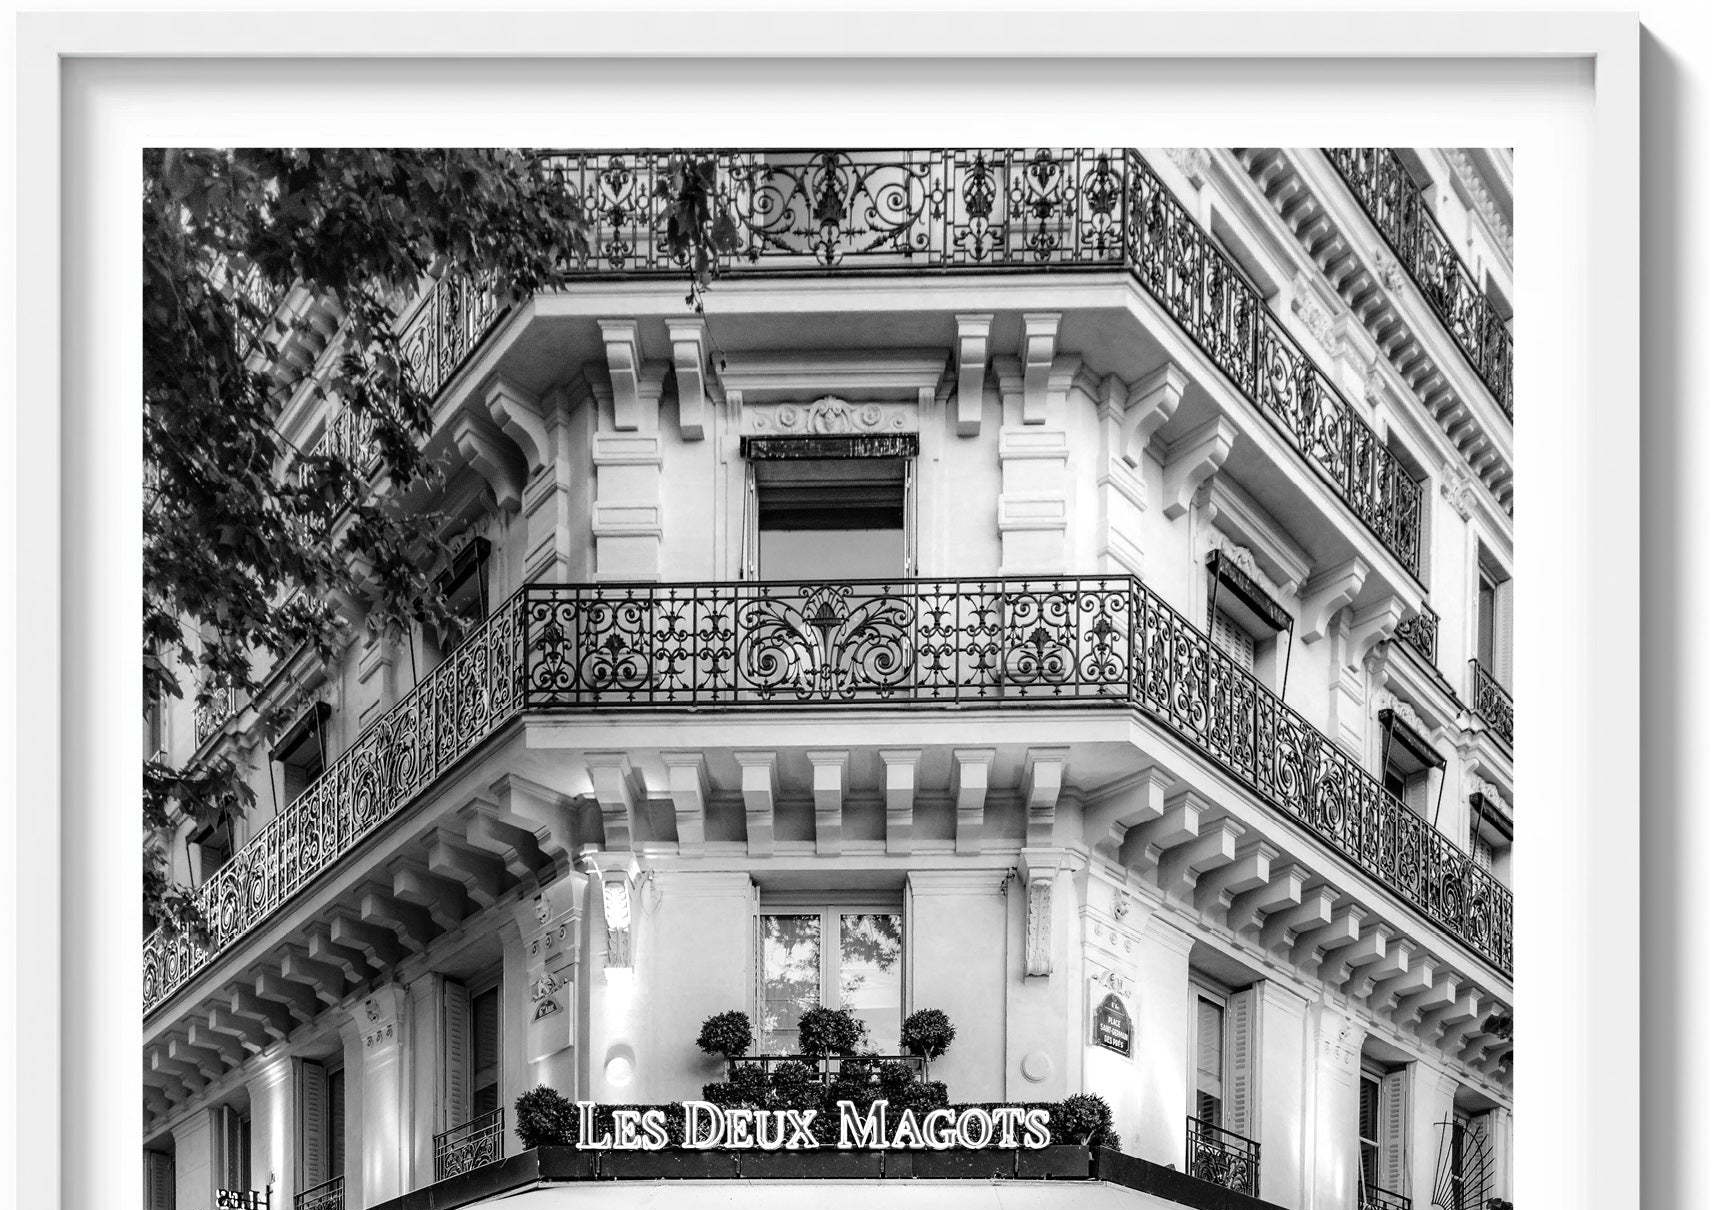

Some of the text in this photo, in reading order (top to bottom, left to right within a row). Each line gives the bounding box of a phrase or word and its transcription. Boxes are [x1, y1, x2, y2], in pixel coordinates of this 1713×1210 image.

[576, 1100, 1051, 1149] LES DEUX MAGOTS
